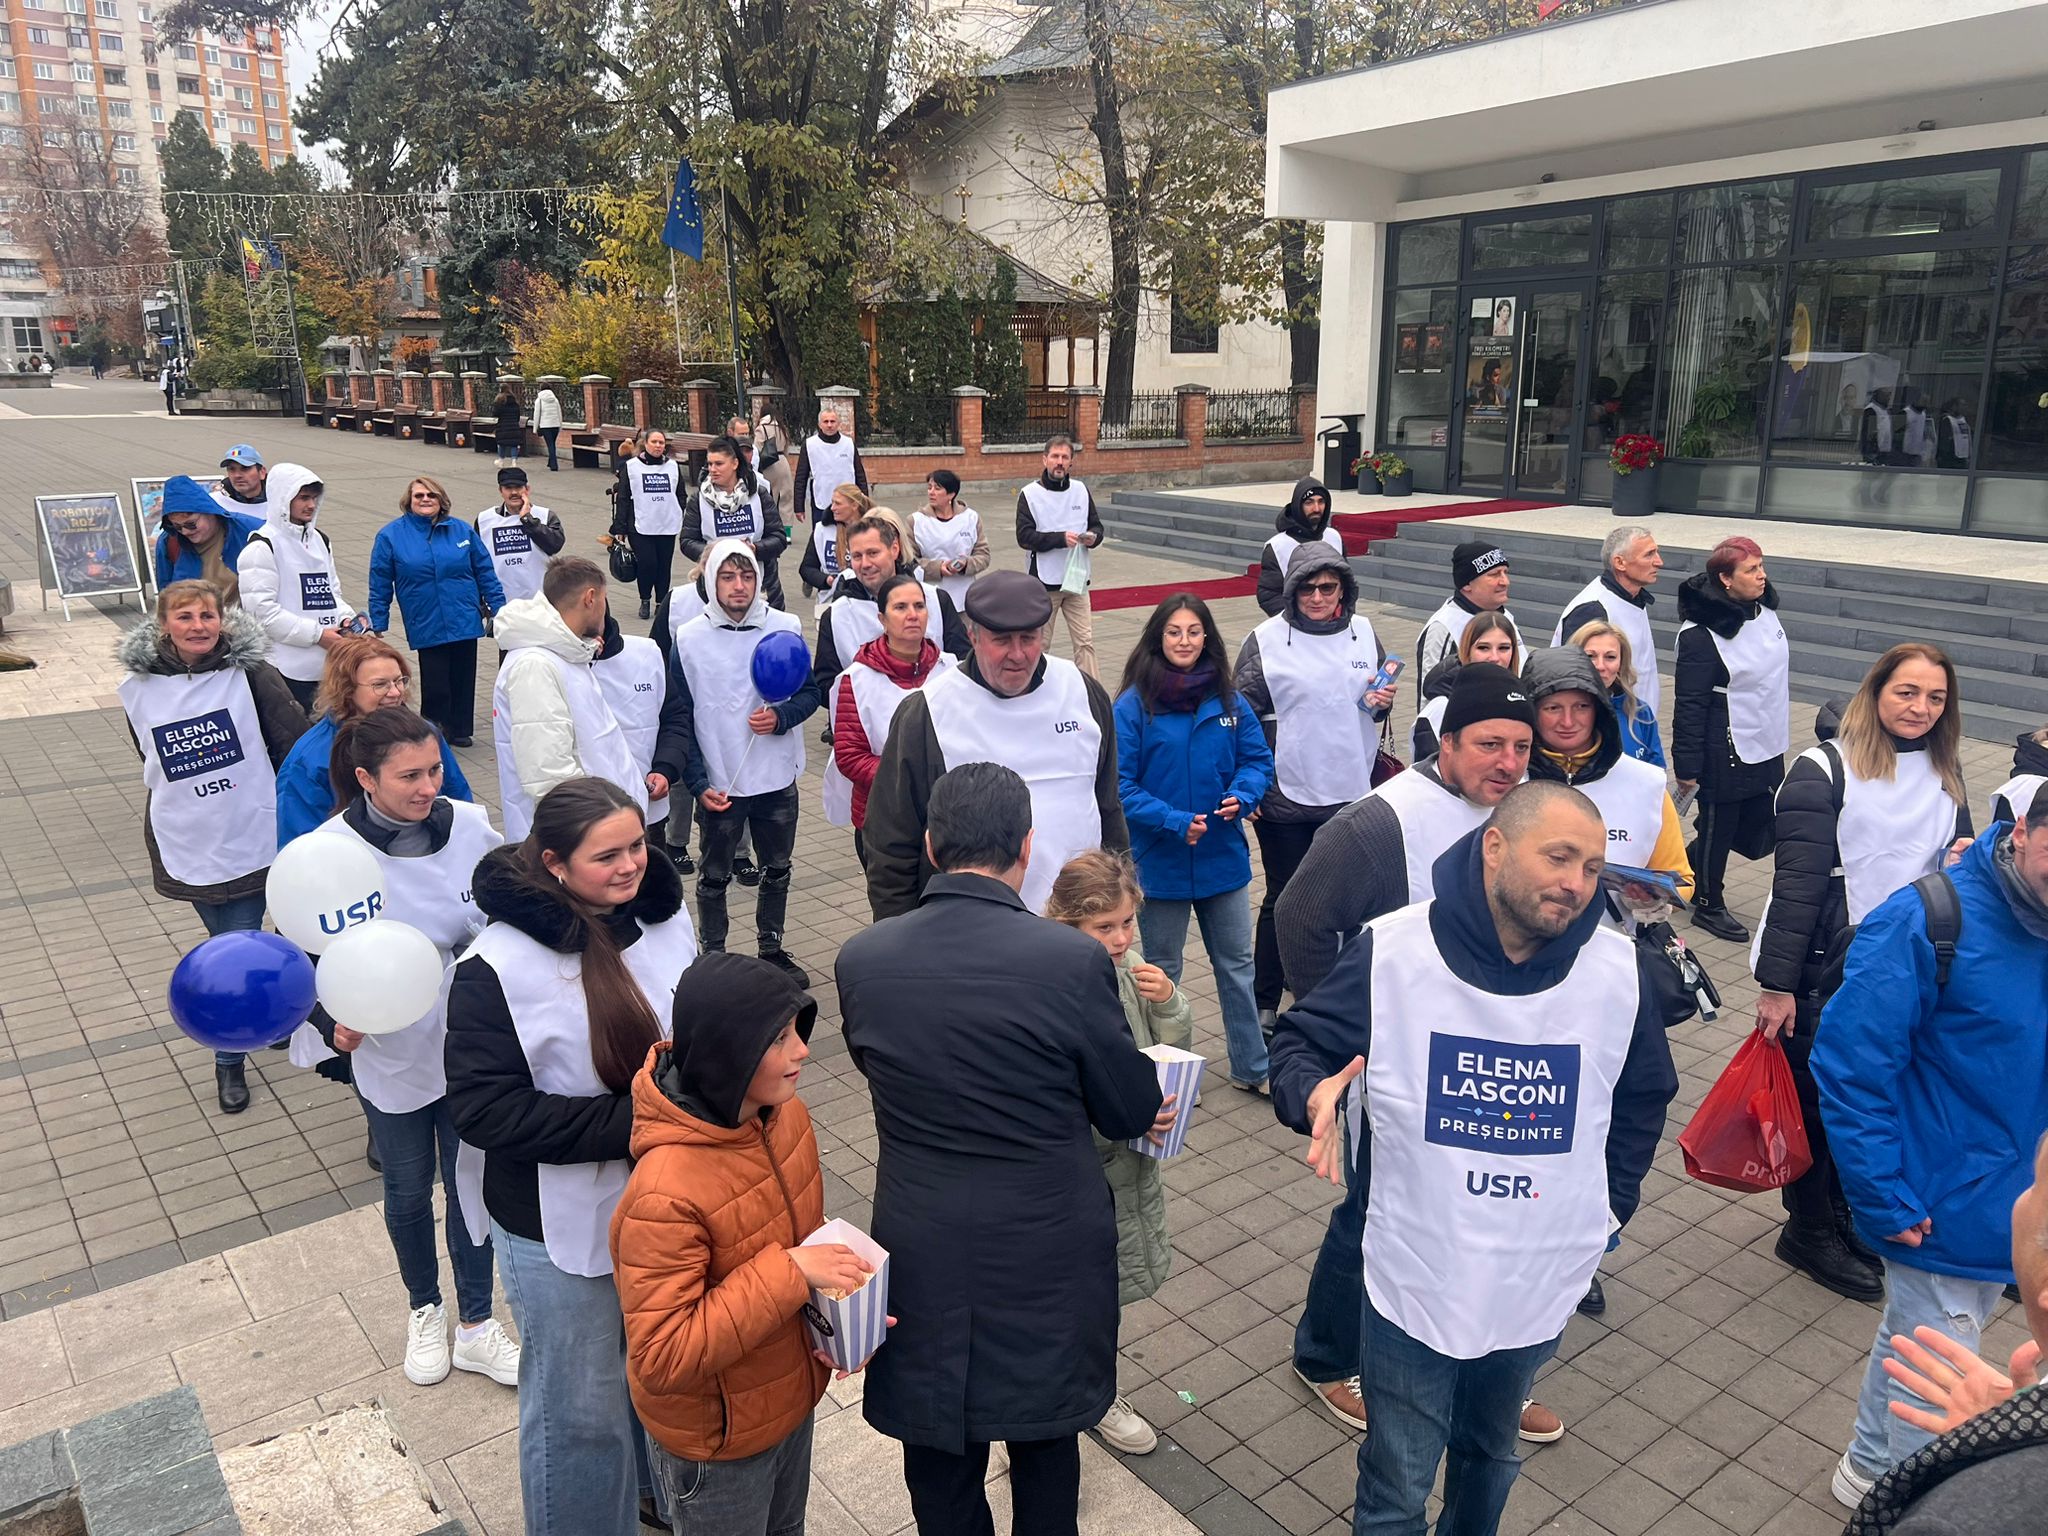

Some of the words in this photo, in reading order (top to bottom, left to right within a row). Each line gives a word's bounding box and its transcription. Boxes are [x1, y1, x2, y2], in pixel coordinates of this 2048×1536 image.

[717, 514, 750, 525] LASCONI
[495, 534, 528, 544] LASCONI
[497, 528, 523, 537] ELENA
[306, 577, 329, 586] ELEN
[162, 729, 231, 757] LASCONI
[165, 720, 219, 743] ELENA
[1608, 829, 1632, 842] SR.
[1457, 1051, 1553, 1081] ELENA
[1441, 1074, 1567, 1106] LASCONI
[1439, 1117, 1563, 1140] PREȘEDINTE
[1466, 1170, 1540, 1200] USR.
